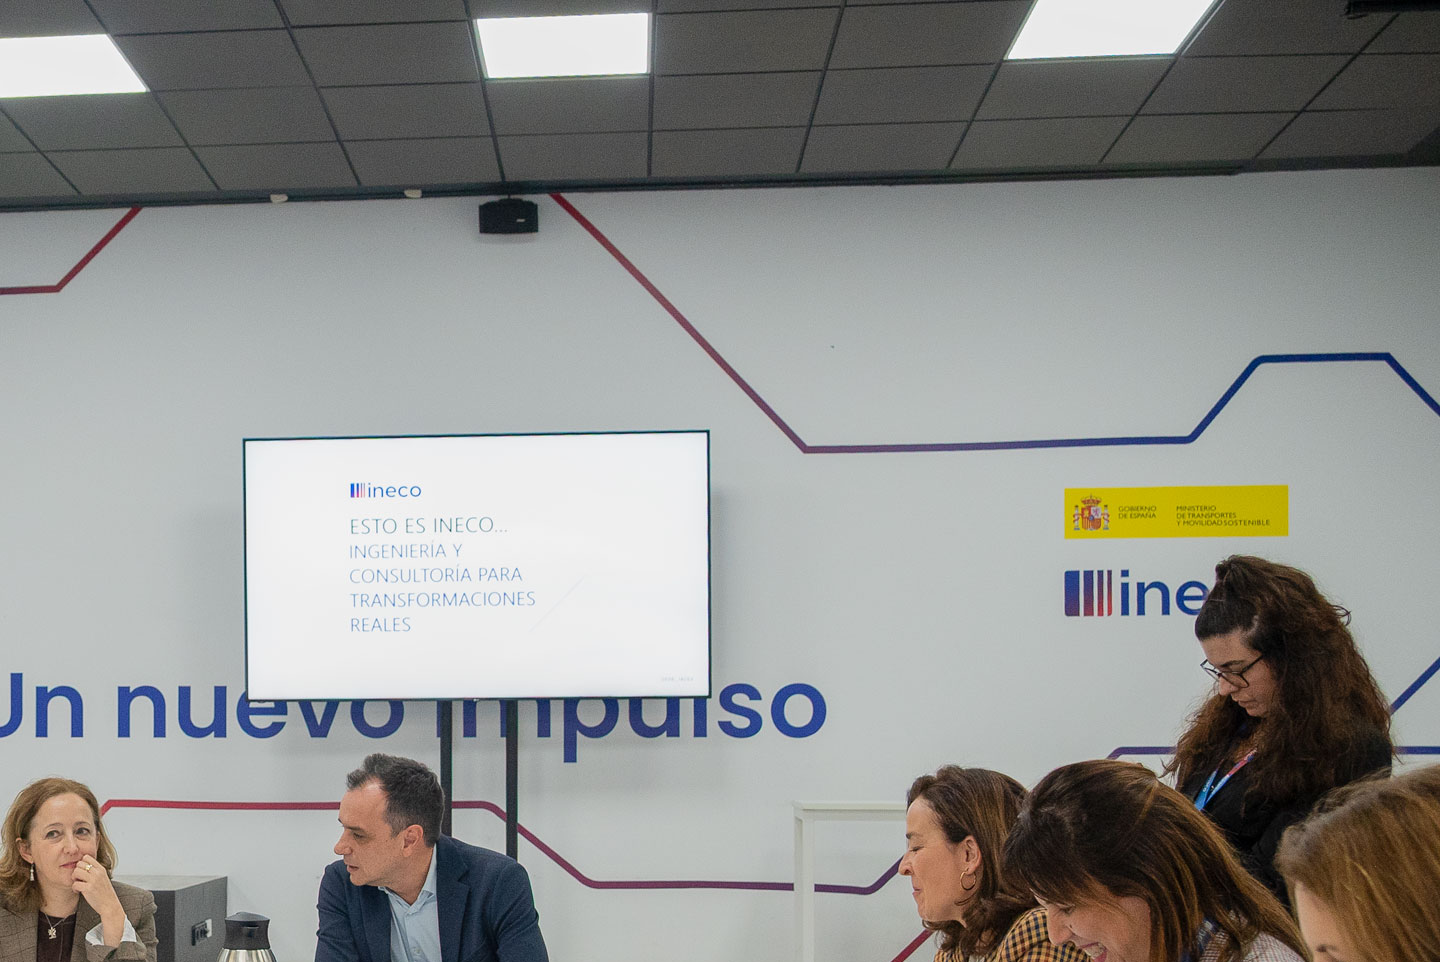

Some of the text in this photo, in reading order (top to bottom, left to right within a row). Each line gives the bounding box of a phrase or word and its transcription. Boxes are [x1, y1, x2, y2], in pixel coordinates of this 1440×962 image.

[368, 483, 422, 498] ineco
[1118, 511, 1157, 520] DE ESPAÑA
[1224, 519, 1271, 527] SOSTENIBLE
[350, 516, 508, 534] ESTO ES INECO...
[349, 540, 463, 559] INGENIERÍA Y
[349, 564, 523, 584] CONSULTORÍA PARA
[350, 591, 536, 608] TRANSFORMACIONES
[1120, 569, 1210, 616] ine
[350, 617, 411, 632] REALES
[117, 685, 405, 739] nuevo
